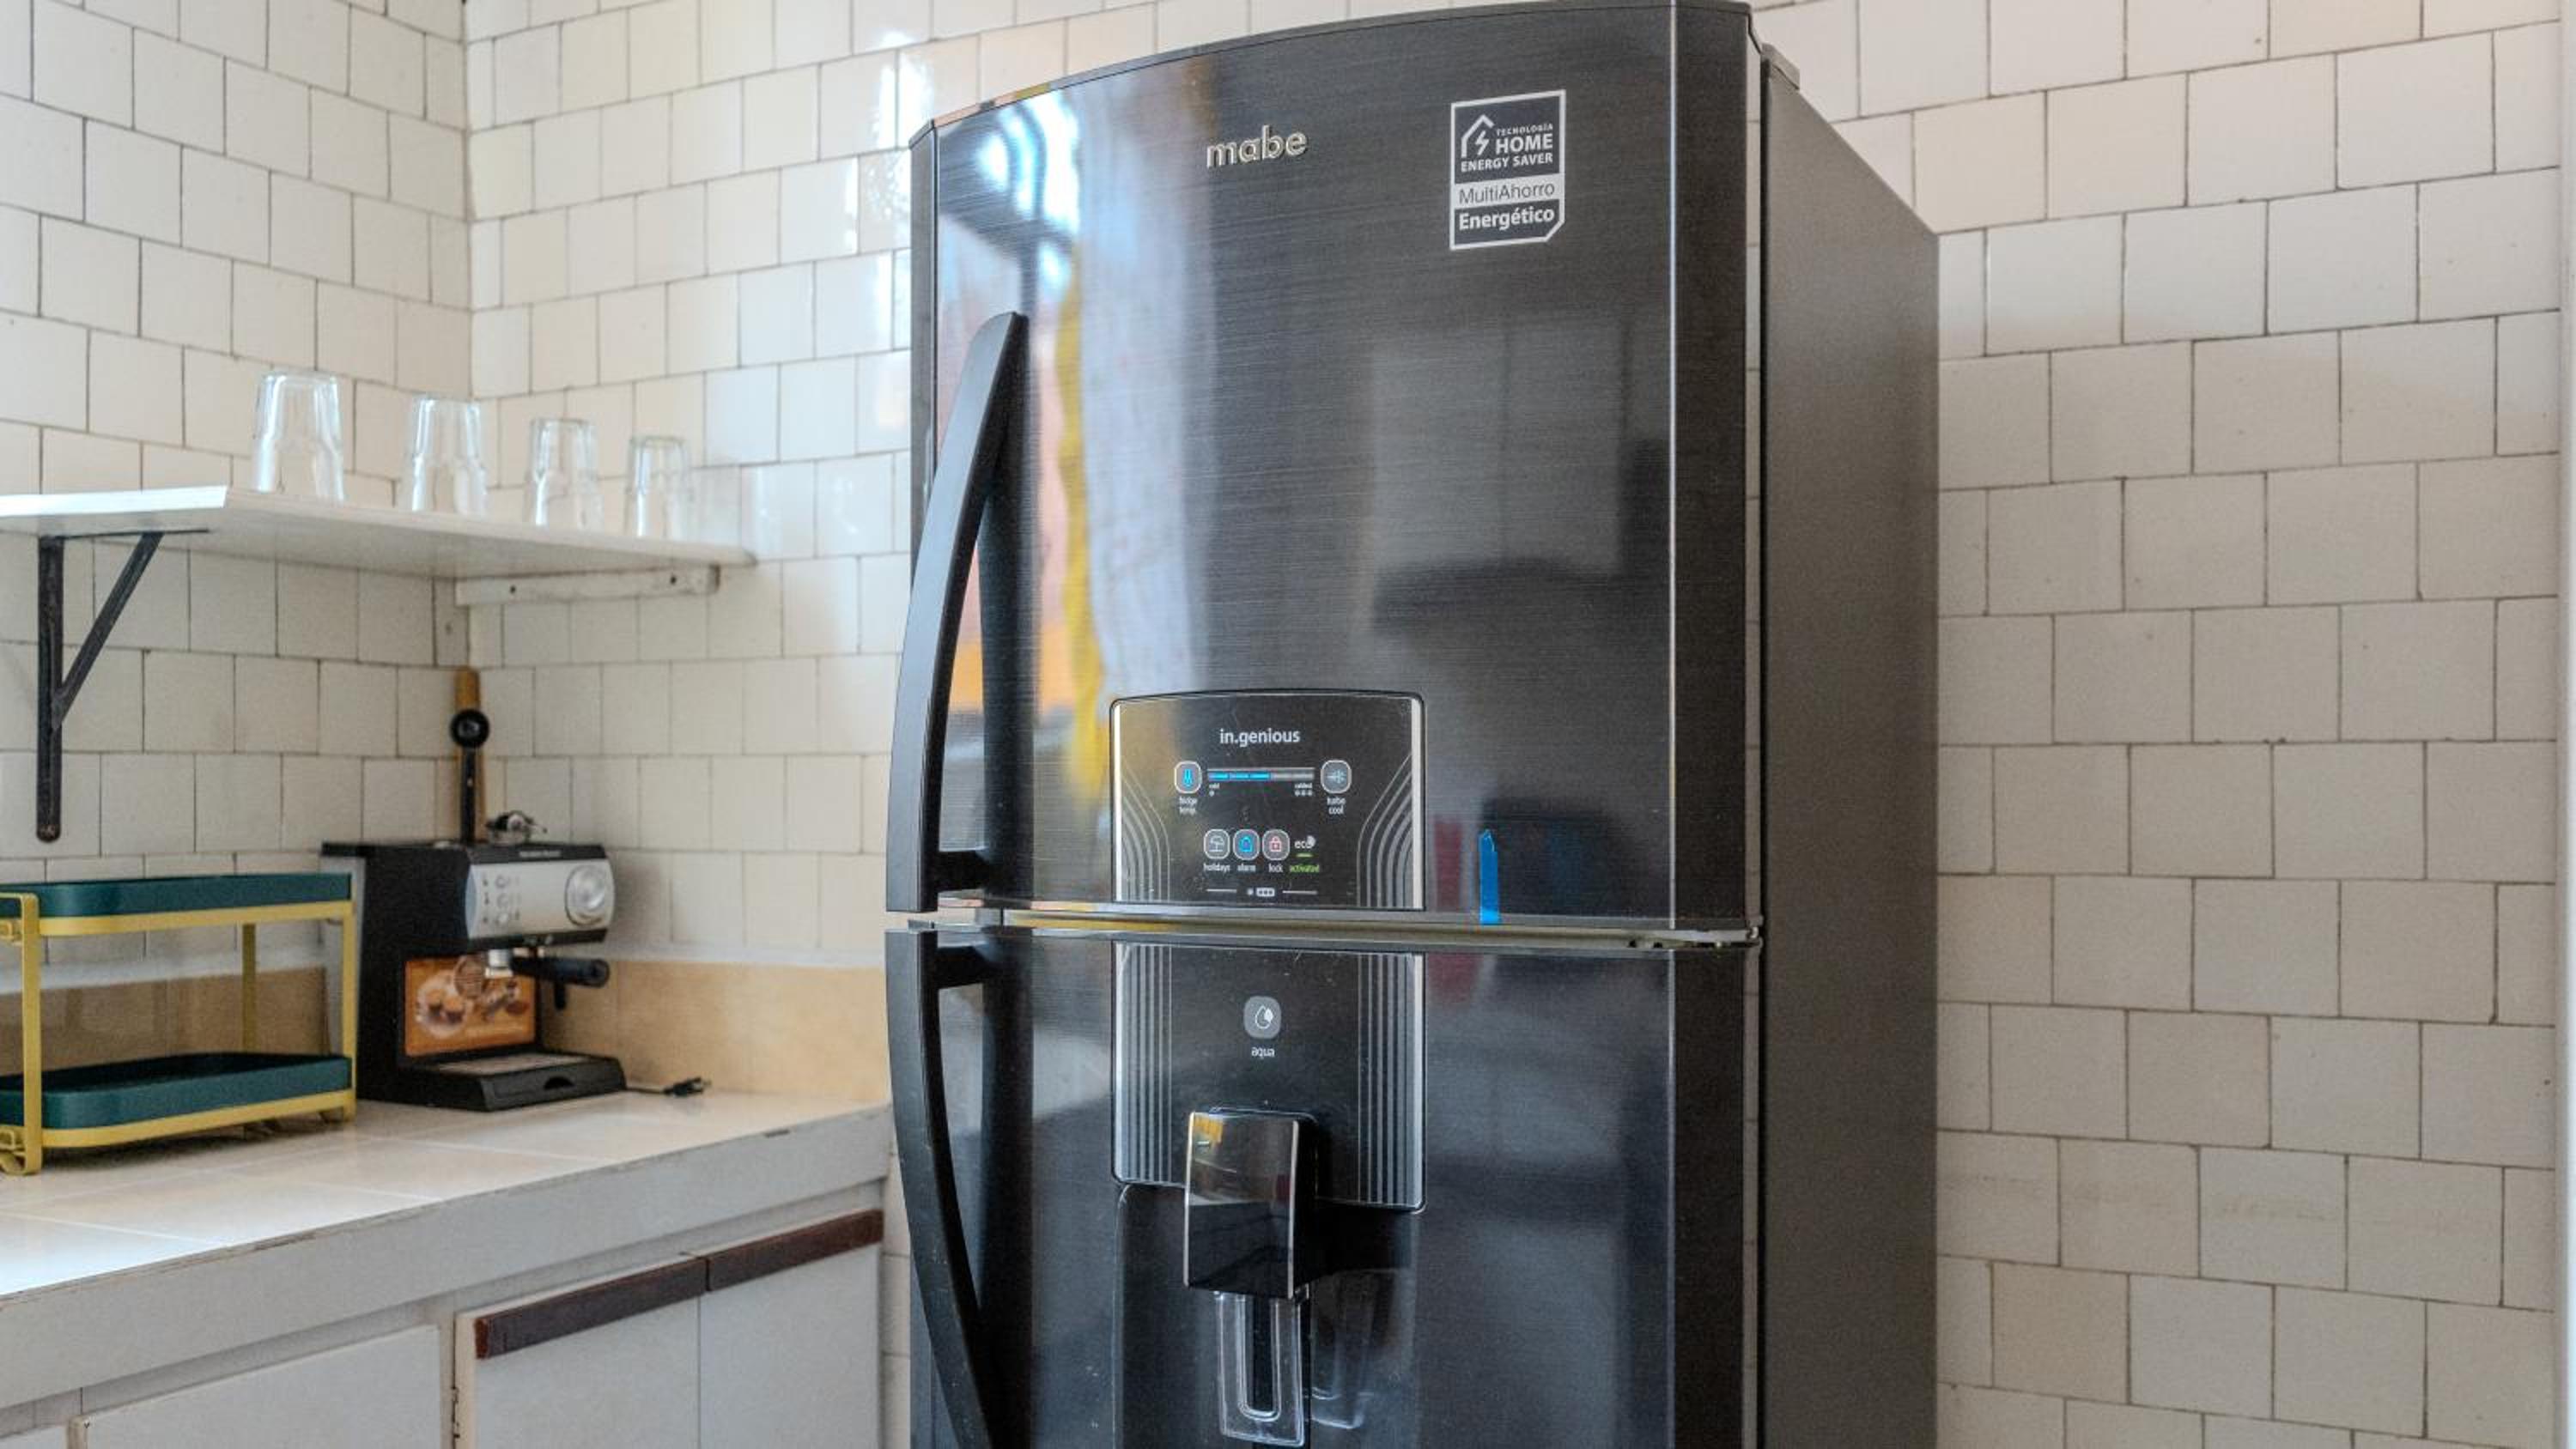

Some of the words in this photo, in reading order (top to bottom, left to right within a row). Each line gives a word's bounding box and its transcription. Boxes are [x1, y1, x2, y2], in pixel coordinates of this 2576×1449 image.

[1206, 124, 1307, 168] mabe
[1496, 133, 1553, 155] HOME
[1461, 156, 1510, 172] ENERGY
[1512, 152, 1553, 167] SAVER
[1460, 183, 1555, 203] MultiAhorro
[1460, 205, 1555, 230] Energético
[1219, 727, 1301, 748] in.genious
[1268, 863, 1284, 873] lock
[1251, 1046, 1275, 1059] aqua
